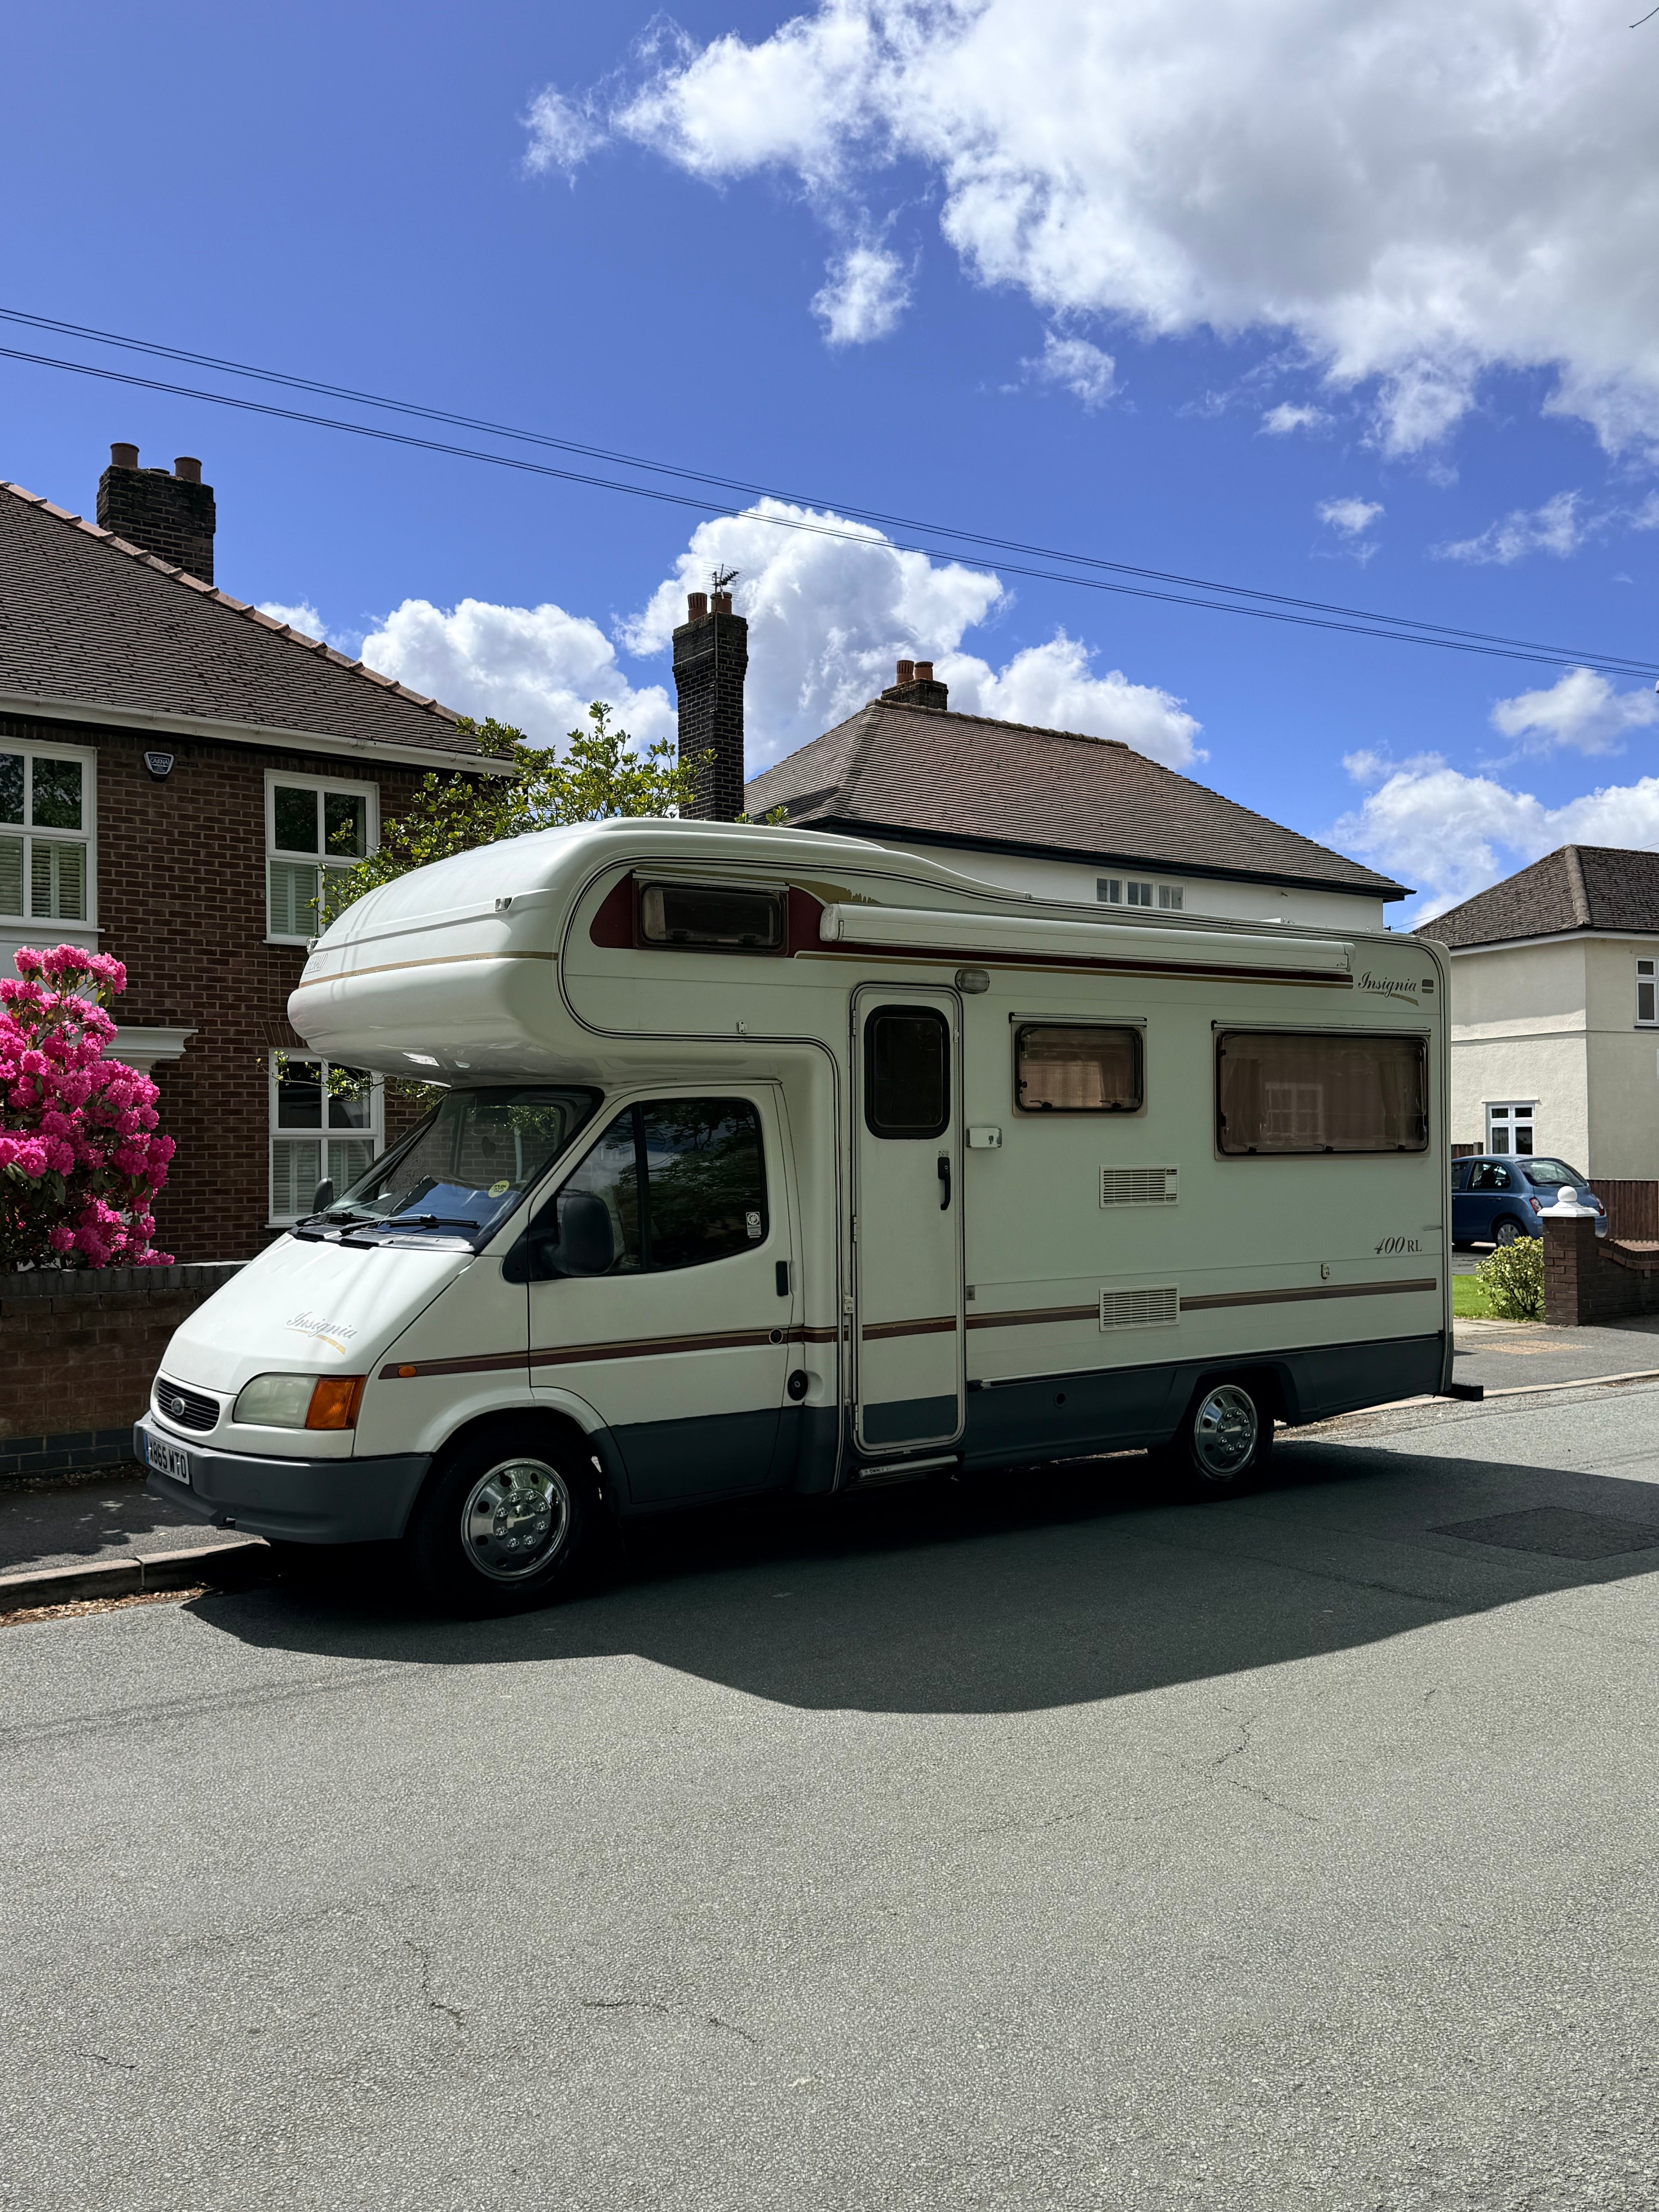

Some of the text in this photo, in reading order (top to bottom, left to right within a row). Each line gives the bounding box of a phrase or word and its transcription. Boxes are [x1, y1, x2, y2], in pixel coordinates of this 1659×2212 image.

[1358, 971, 1417, 998] Insignia
[1373, 1236, 1422, 1254] 400 RL
[286, 1312, 358, 1347] Insignia
[149, 1437, 187, 1478] X865 WTO
